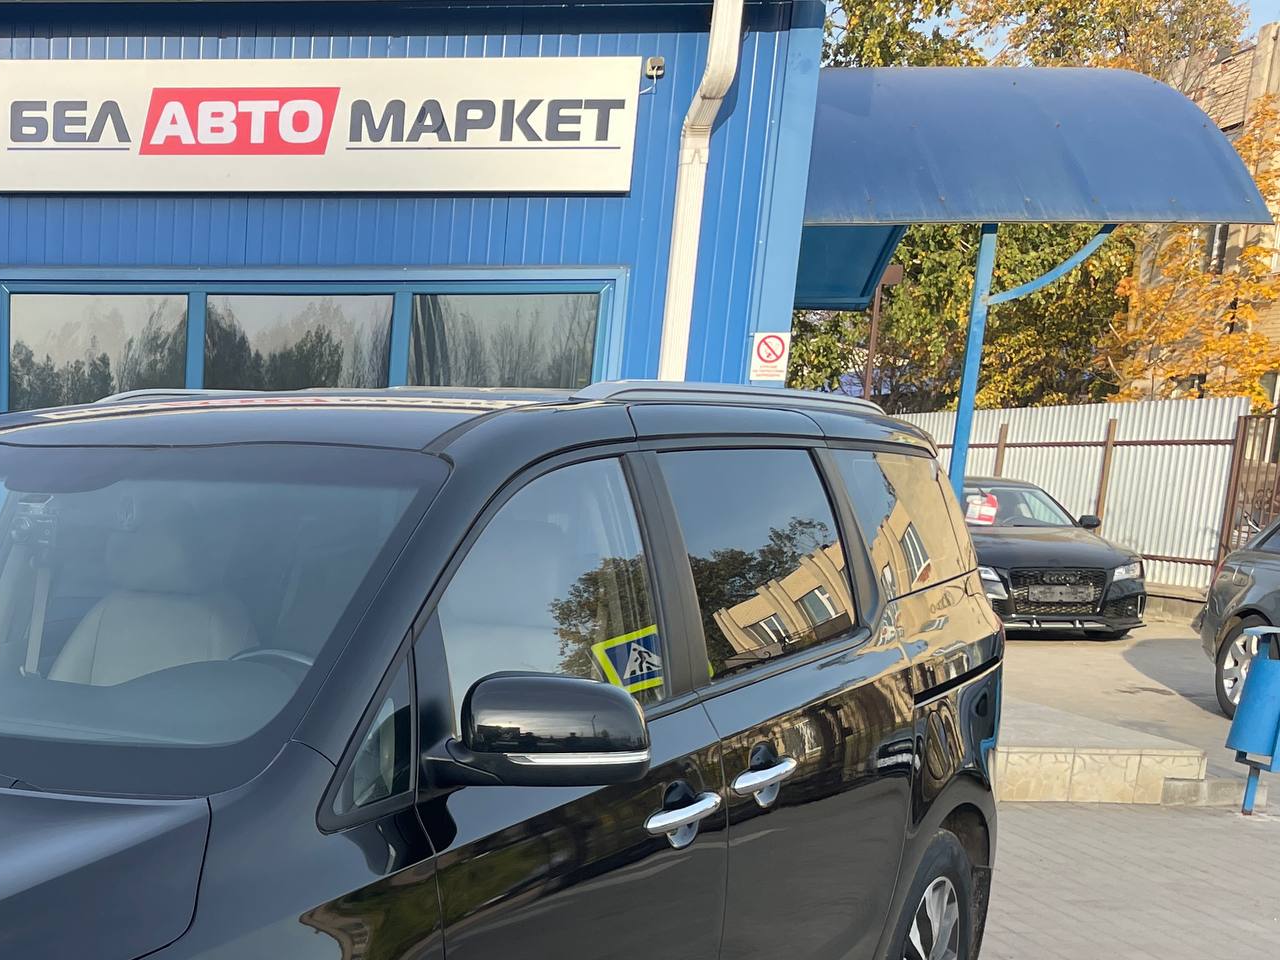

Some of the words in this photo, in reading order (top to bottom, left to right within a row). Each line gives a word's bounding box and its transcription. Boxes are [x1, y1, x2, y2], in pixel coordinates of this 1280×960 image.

[9, 100, 132, 143] БЕЛ
[149, 99, 324, 145] АВТО
[349, 99, 626, 143] МАРКЕТ
